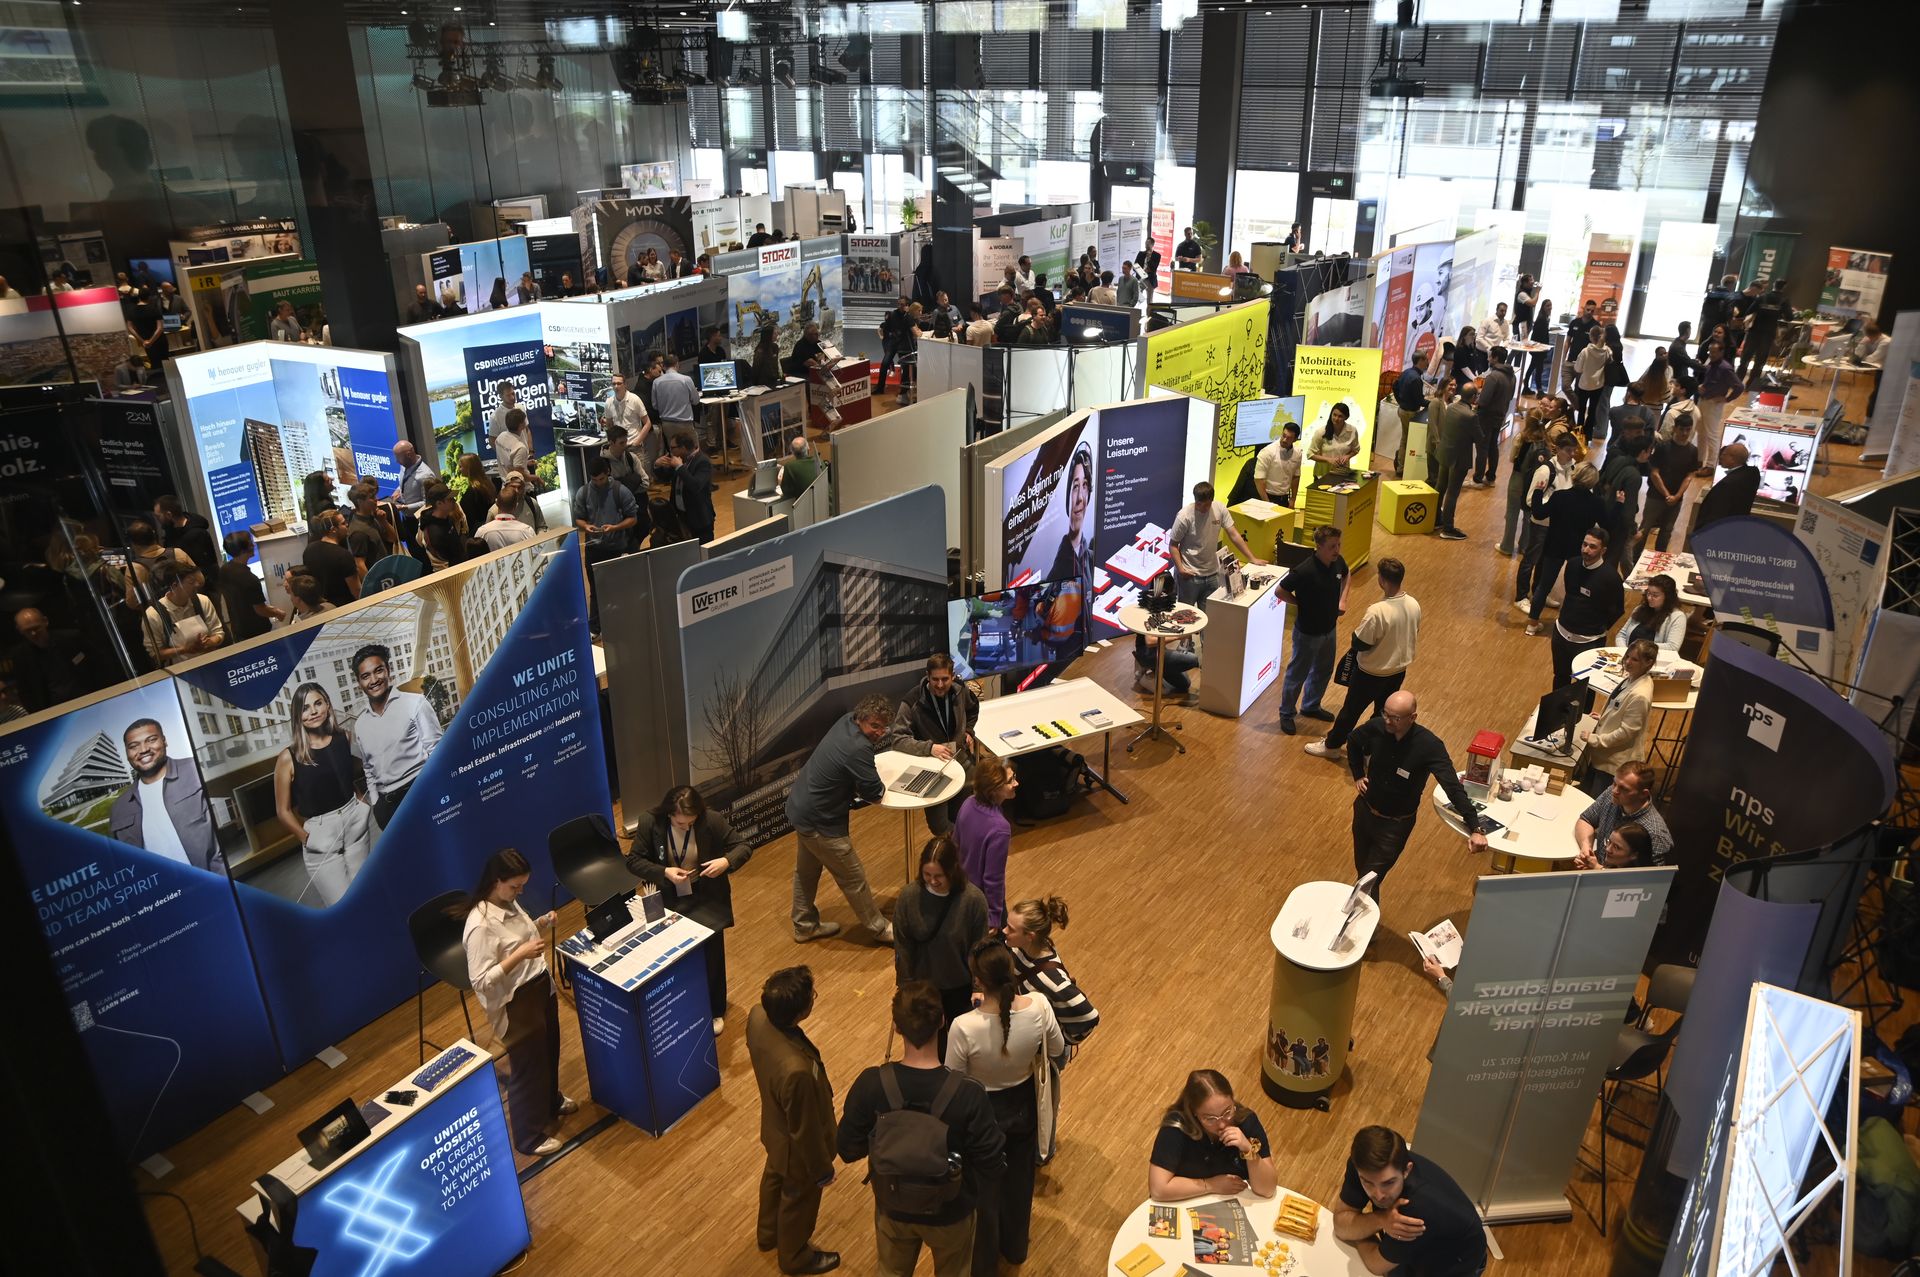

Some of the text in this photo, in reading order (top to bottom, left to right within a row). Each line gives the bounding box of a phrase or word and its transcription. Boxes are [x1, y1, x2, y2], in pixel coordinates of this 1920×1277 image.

[851, 238, 880, 248] STORZ
[1050, 223, 1067, 240] KuP
[762, 248, 791, 264] STORZ
[292, 286, 321, 295] KARRIER
[218, 360, 267, 377] henauer gugler
[474, 350, 535, 371] CSDINGENIEURE
[1300, 356, 1356, 367] Mobilitäts-
[477, 374, 527, 395] Unre
[1299, 367, 1356, 379] verwaltung
[350, 389, 388, 405] henauer gugler
[1106, 445, 1148, 459] Leistungen
[1107, 436, 1135, 448] Unsere
[0, 457, 46, 477] olz.
[1105, 473, 1126, 481] Hochbau
[1009, 465, 1064, 511] Alles beginnt mit
[1008, 509, 1030, 530] einem
[693, 585, 738, 611] WETTER
[228, 655, 277, 680] DREES &
[229, 664, 278, 687] SOMMER
[512, 649, 576, 688] WE UNITE
[469, 669, 577, 730] CONSULTING AND
[472, 688, 580, 750] IMPLEMENTATION
[1742, 702, 1774, 727] nps
[458, 761, 474, 774] Real
[498, 729, 543, 755] Infrastructure
[543, 722, 555, 734] and
[560, 732, 576, 745] 1970
[0, 752, 29, 768] MER
[524, 753, 533, 763] 37
[440, 795, 450, 805] 63
[1730, 784, 1775, 826] nps
[1724, 807, 1765, 849] Wir
[46, 862, 100, 897] UNITE
[38, 864, 136, 921] DIVIDUALITY
[66, 872, 160, 928] TEAM SPIRIT
[60, 889, 182, 956] you can have both why decide?
[120, 942, 142, 956] Thesis
[139, 942, 159, 955] career
[159, 920, 199, 945] opportunities
[120, 988, 139, 1003] MORE
[645, 975, 675, 1001] INDUSTRY
[656, 1036, 678, 1057] Technology
[434, 1107, 478, 1145] UNITING
[420, 1119, 481, 1170] OPPOSITES
[431, 1131, 484, 1176] TO CREATE
[441, 1144, 486, 1185] A WORLD
[442, 1155, 488, 1197] WE WANT
[441, 1167, 491, 1211] TO LIVE IN
